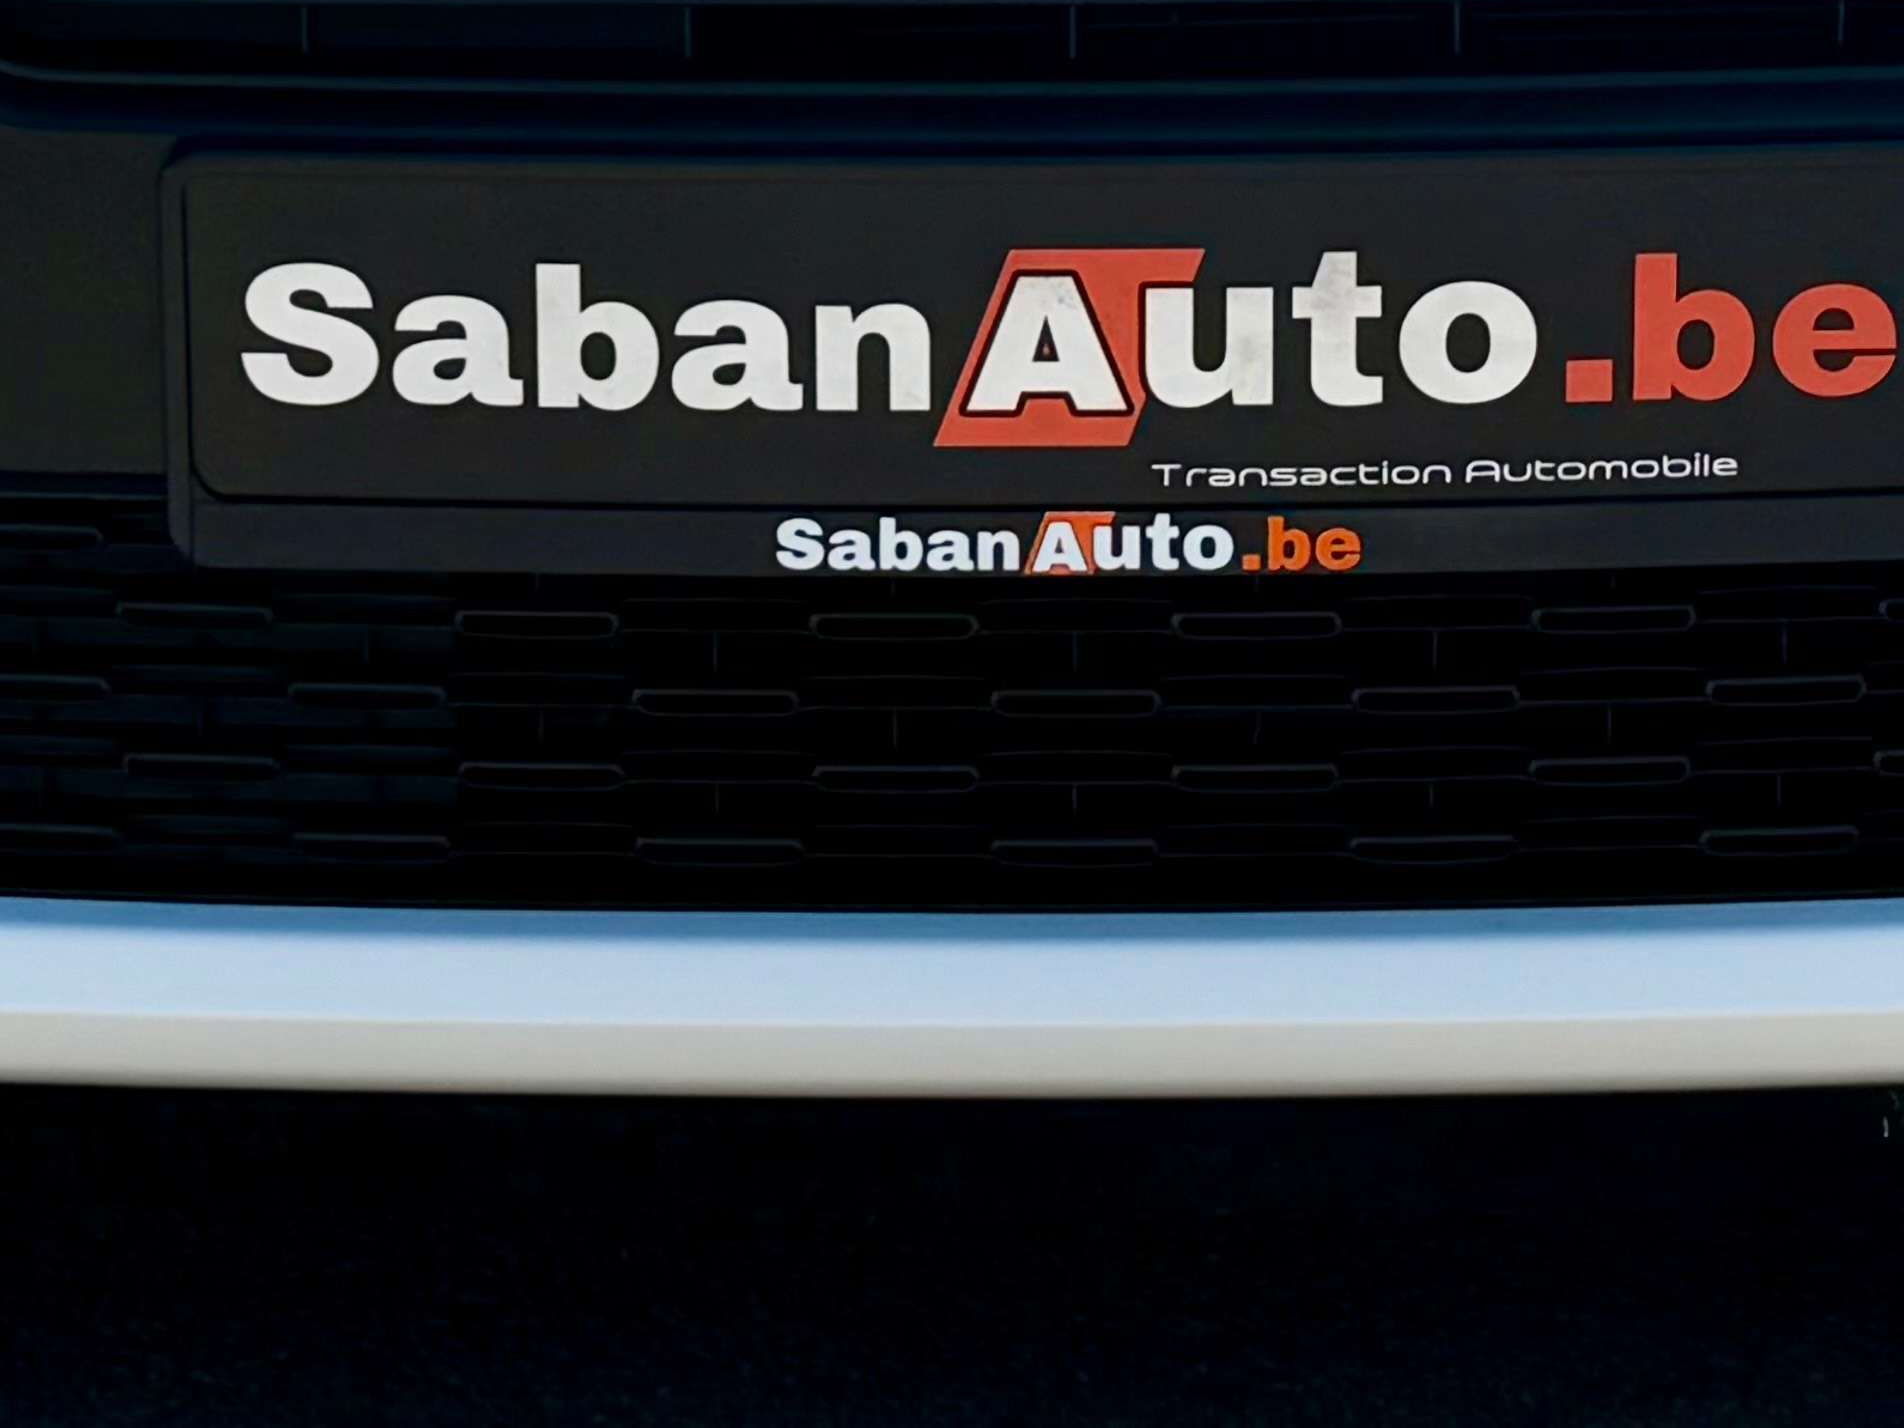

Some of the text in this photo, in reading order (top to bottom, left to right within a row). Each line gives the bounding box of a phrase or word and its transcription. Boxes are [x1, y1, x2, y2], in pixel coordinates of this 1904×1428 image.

[240, 247, 1900, 447] SabanAuto.be
[1152, 451, 1739, 489] Transaction Automobile
[774, 511, 1362, 576] SabanAuto.be
